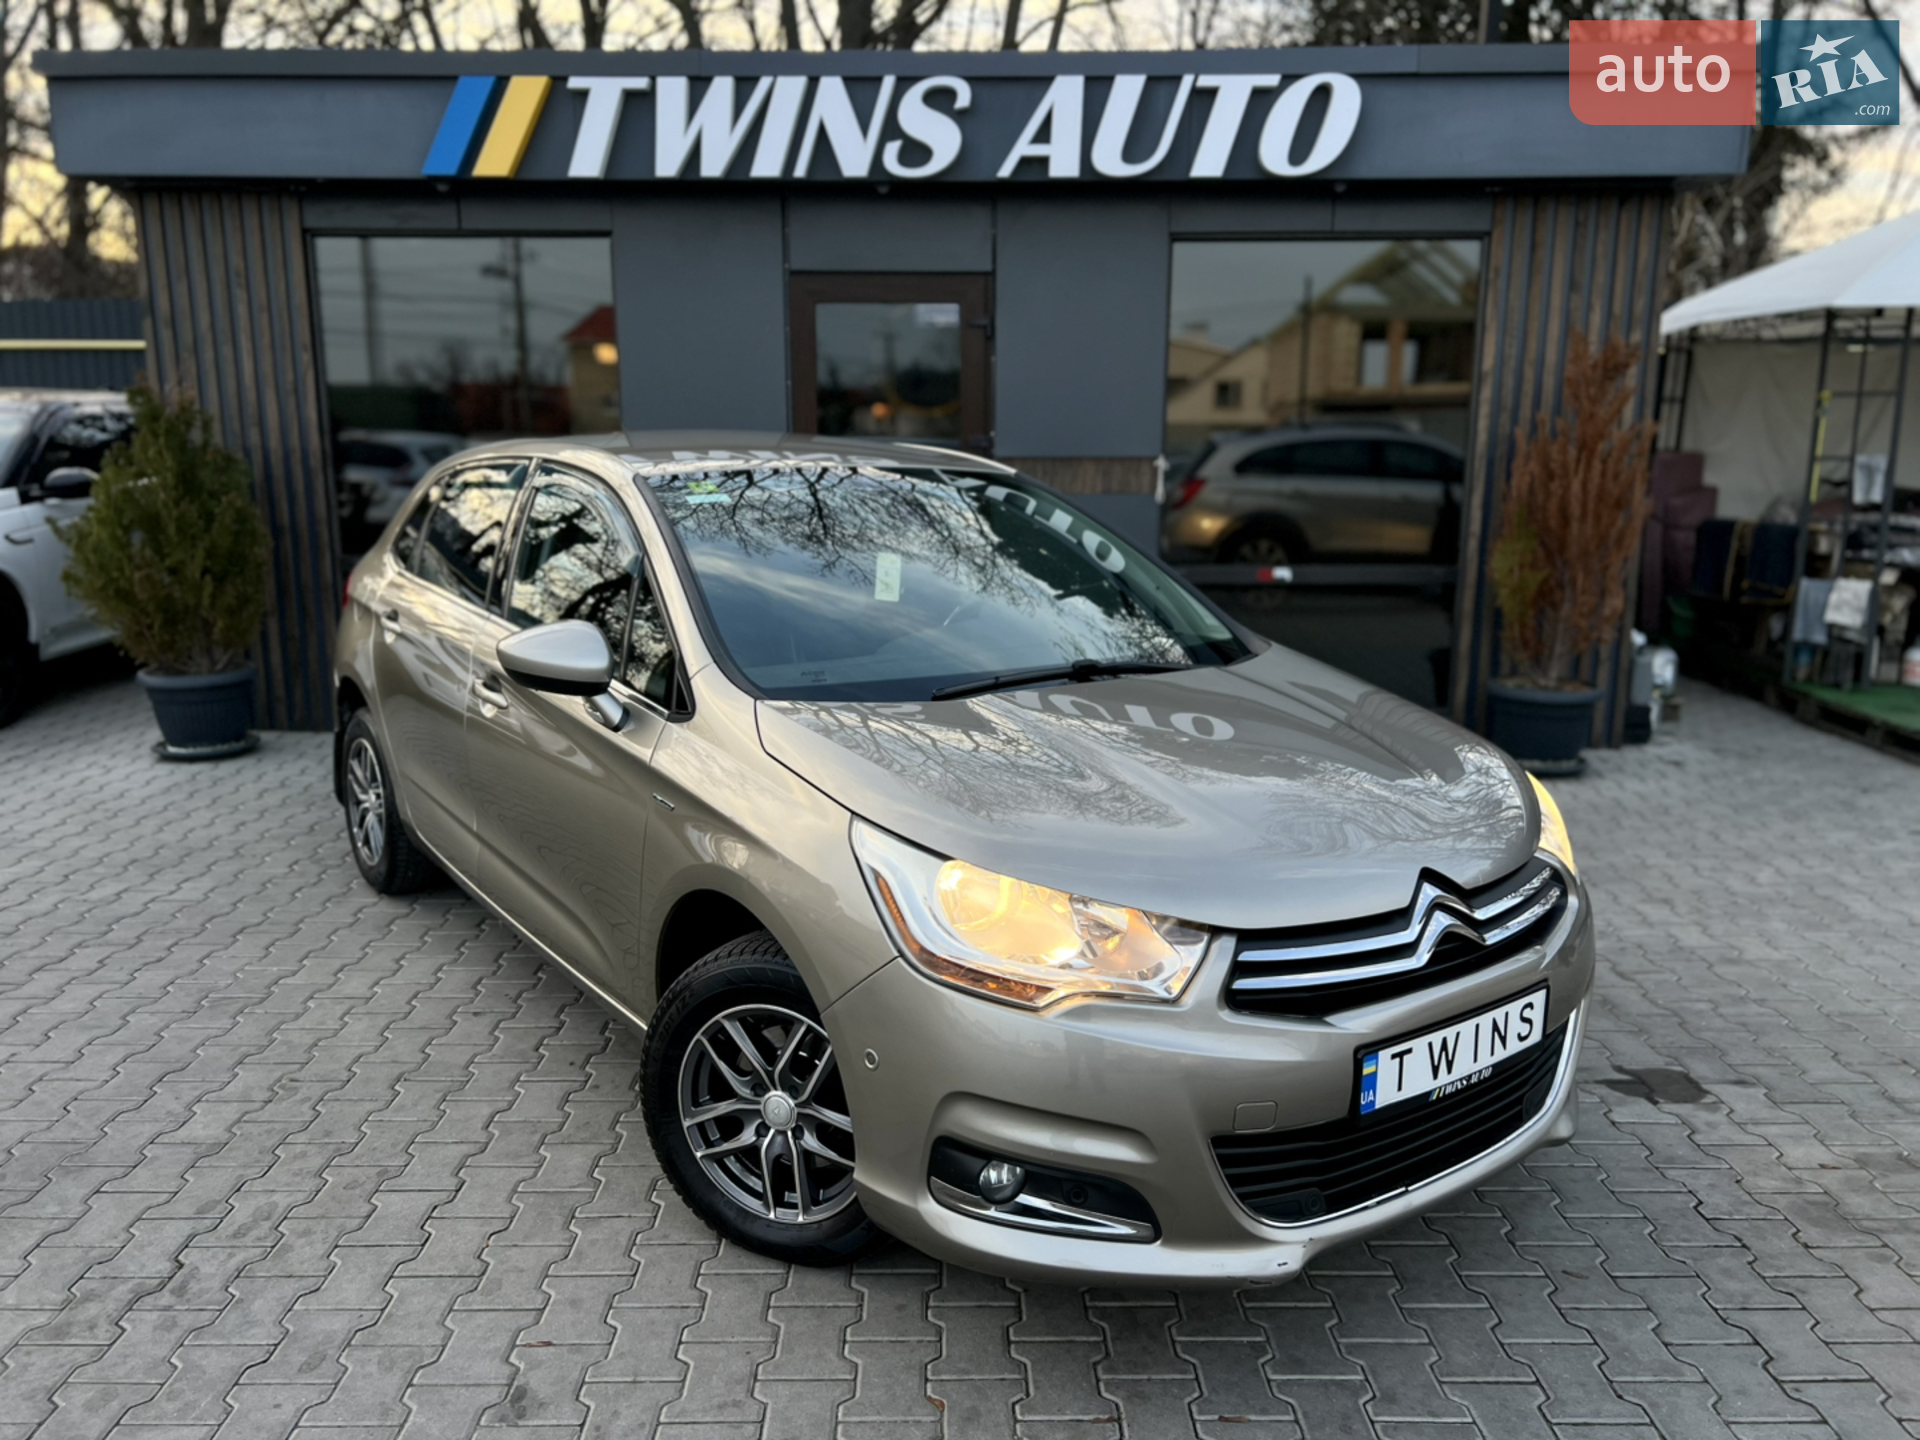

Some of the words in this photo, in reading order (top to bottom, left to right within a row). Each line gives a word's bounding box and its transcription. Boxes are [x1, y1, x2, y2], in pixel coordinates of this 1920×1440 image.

[566, 74, 972, 178] TWINS
[996, 72, 1362, 178] AUTO
[1391, 1002, 1534, 1092] TWINS
[1361, 1089, 1374, 1105] UA
[1439, 1077, 1469, 1098] TWINS
[1469, 1066, 1493, 1085] AUTO
